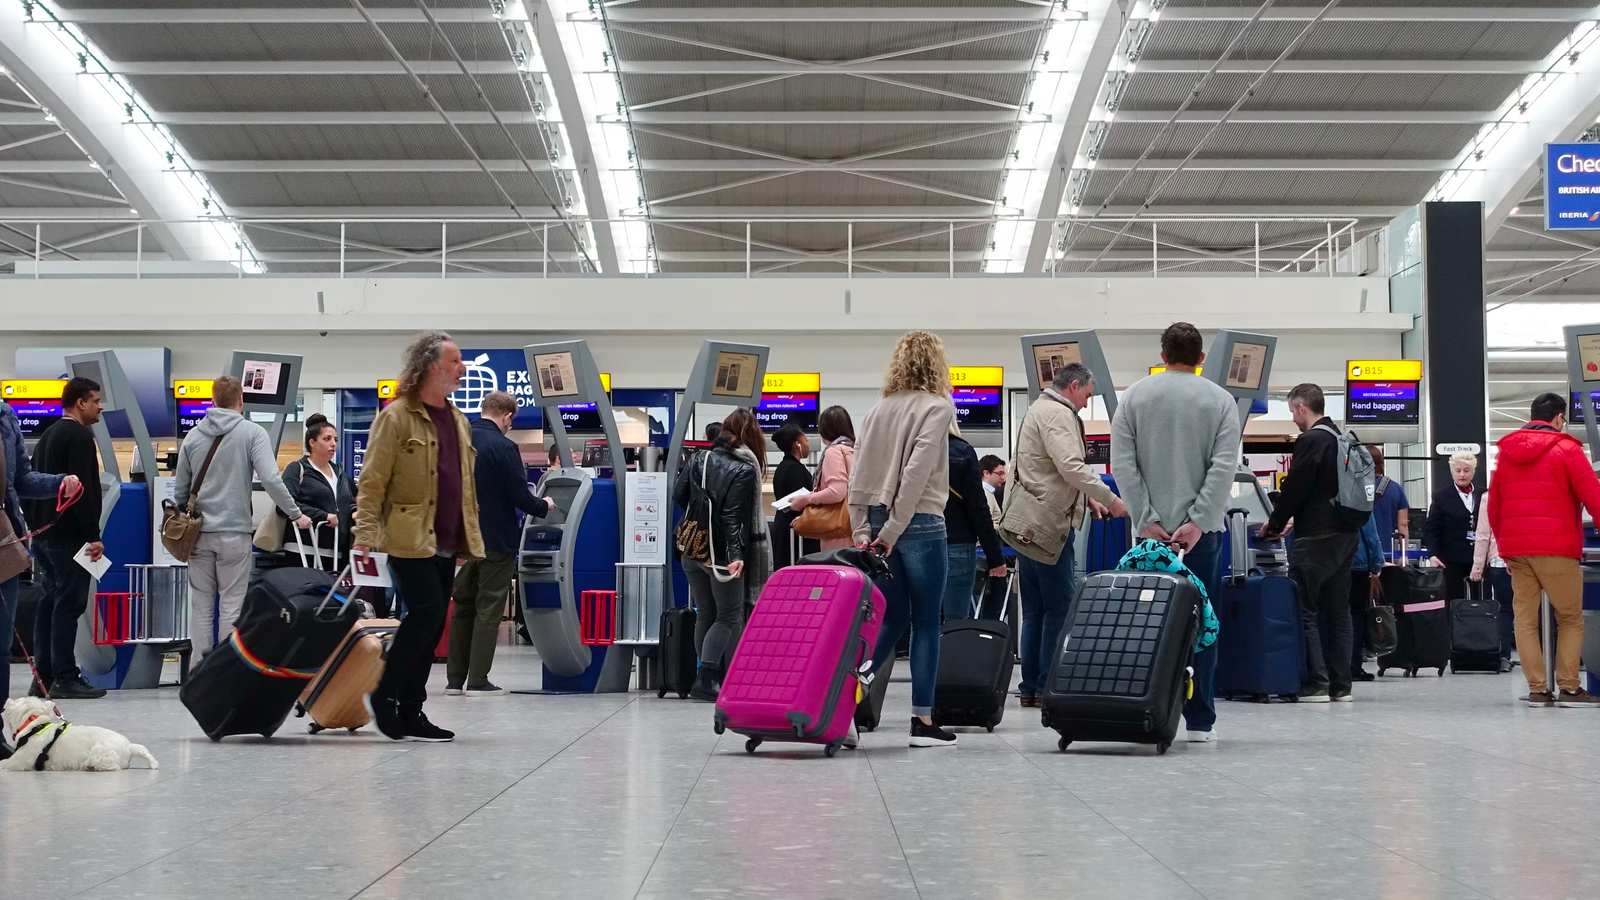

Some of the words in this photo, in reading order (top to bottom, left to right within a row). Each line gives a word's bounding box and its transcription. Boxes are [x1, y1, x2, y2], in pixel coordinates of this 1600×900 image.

[1364, 366, 1383, 375] B15
[766, 379, 784, 387] B12
[16, 385, 28, 393] B8
[189, 385, 201, 393] B9
[1351, 402, 1371, 410] Hand
[1372, 402, 1406, 411] baggage
[562, 413, 579, 421] drop
[756, 413, 770, 421] Bag
[771, 413, 788, 421] drop
[22, 418, 40, 426] drop
[180, 418, 194, 426] Bag
